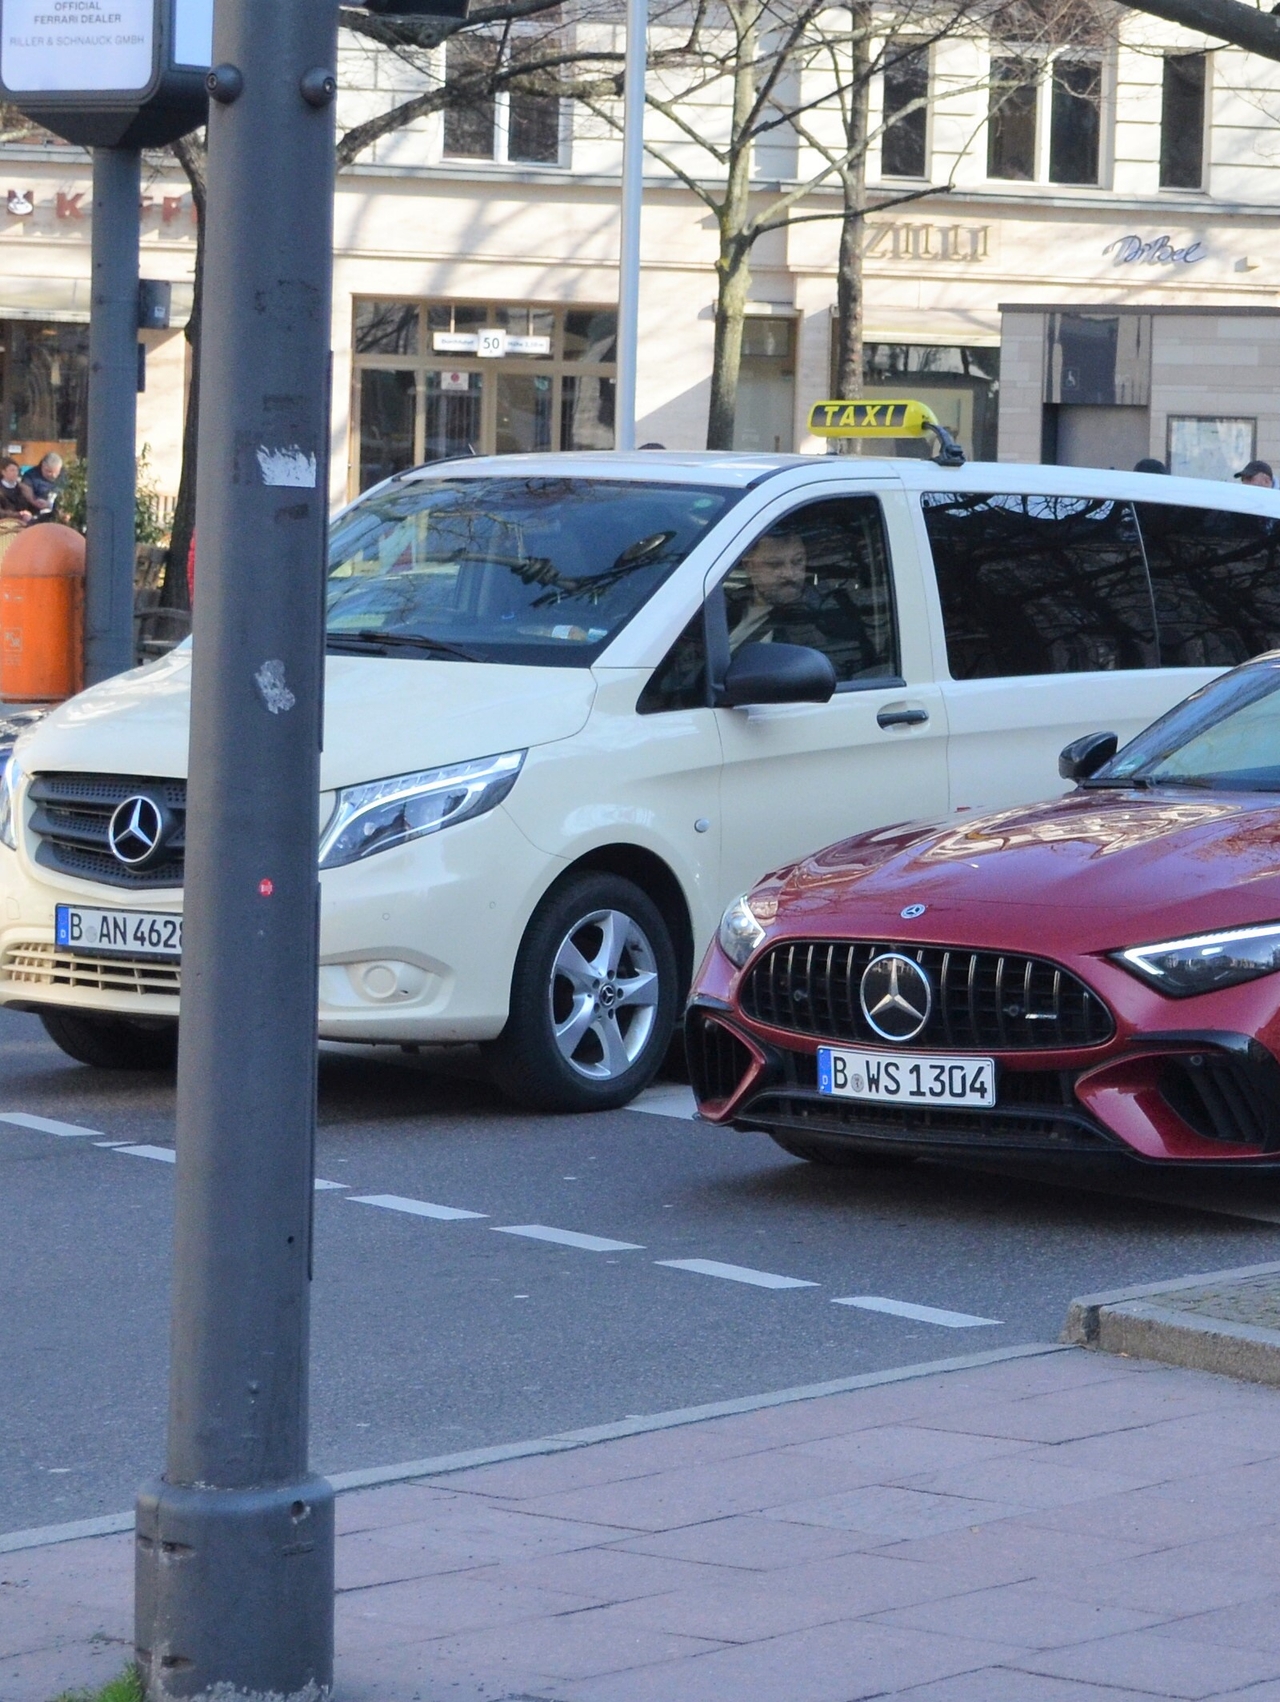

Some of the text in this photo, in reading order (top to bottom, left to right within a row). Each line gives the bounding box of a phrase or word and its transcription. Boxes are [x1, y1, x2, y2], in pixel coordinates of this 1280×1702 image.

[54, 1, 101, 11] OFFICIAL
[34, 14, 121, 24] FERRARI DEALER
[9, 35, 144, 47] RILLER & SCHNAUCK GMBH
[863, 222, 992, 263] ZILLI
[483, 337, 500, 349] 50
[823, 405, 895, 427] TAXI
[70, 913, 183, 949] B AN 462
[833, 1056, 987, 1099] B WS 1304
